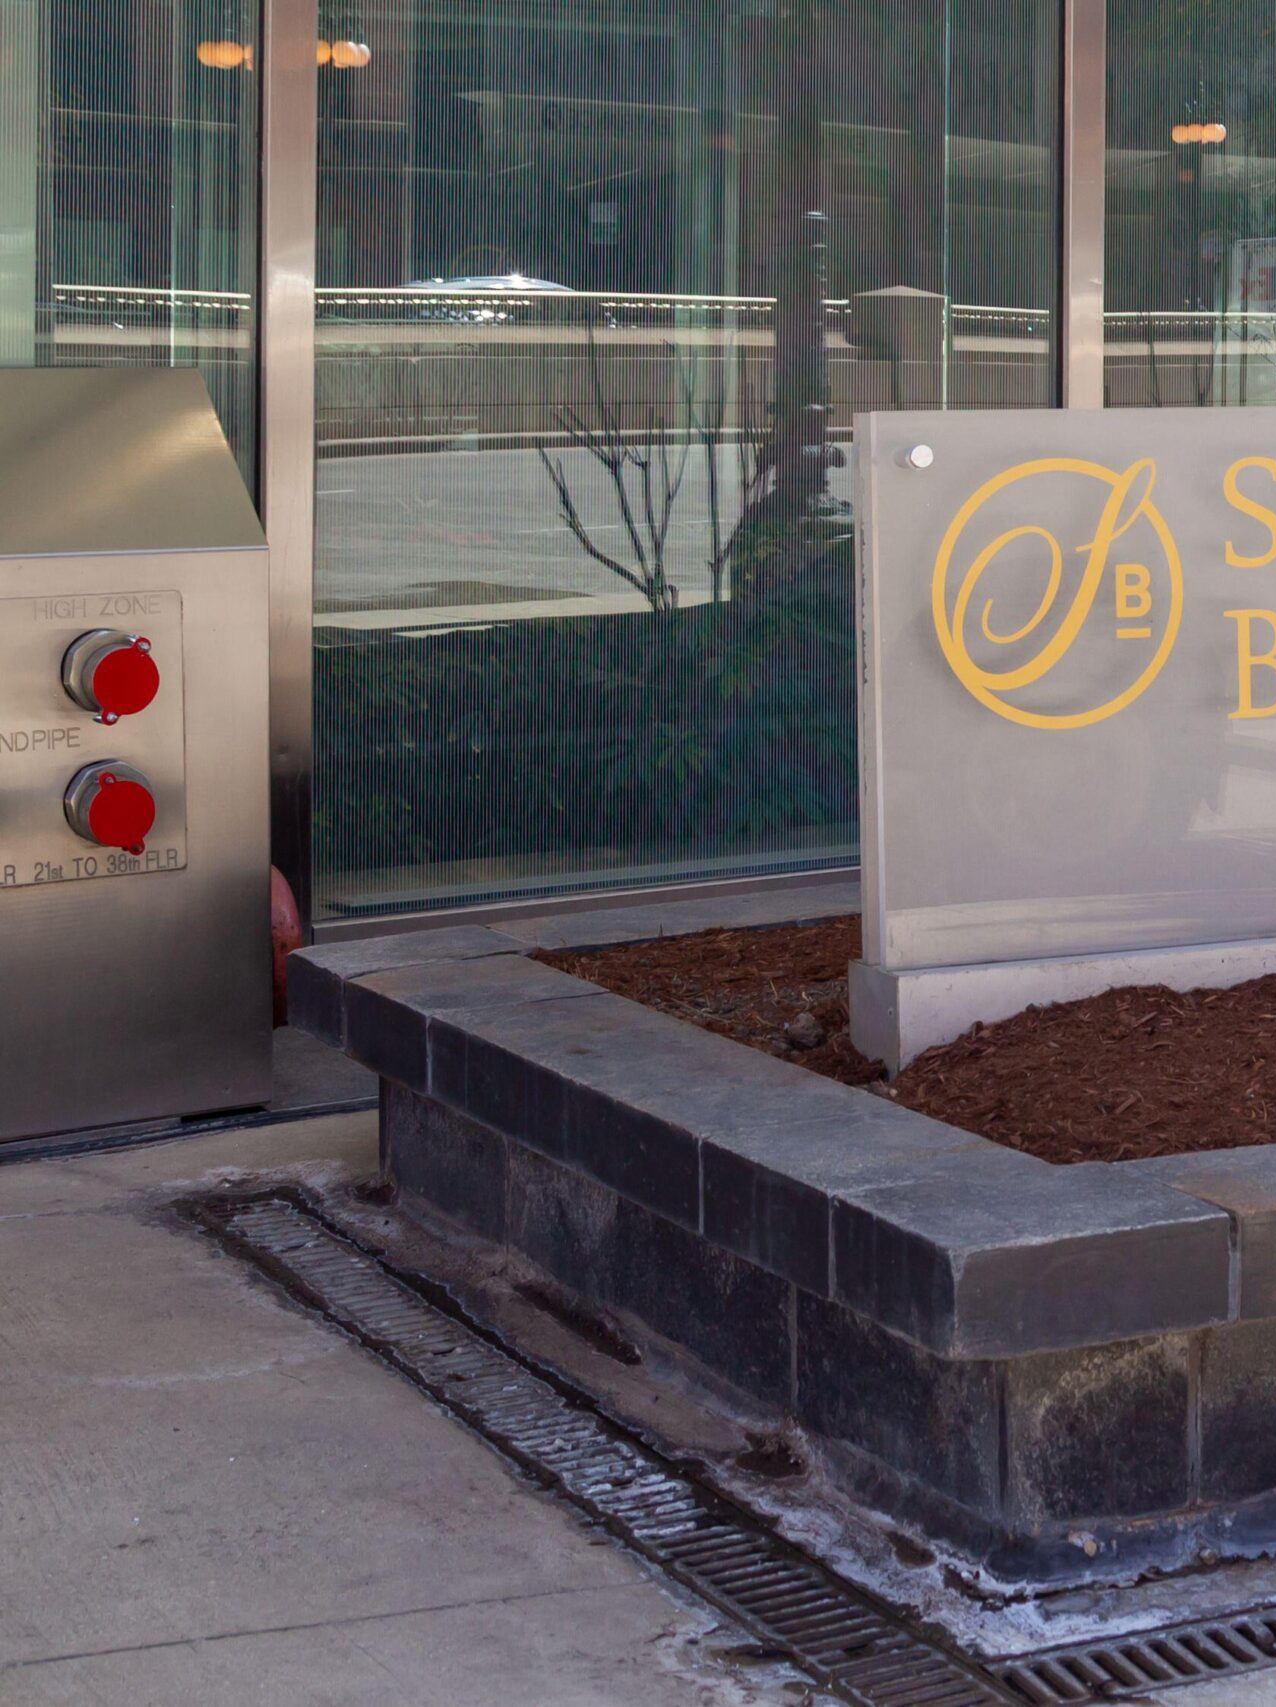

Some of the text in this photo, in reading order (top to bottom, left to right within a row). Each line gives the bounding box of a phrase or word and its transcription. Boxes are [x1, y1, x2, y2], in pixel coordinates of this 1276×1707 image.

[33, 595, 162, 620] HIGH ZONE
[0, 864, 16, 884] R
[34, 848, 179, 882] 21st TO 38th FLR
